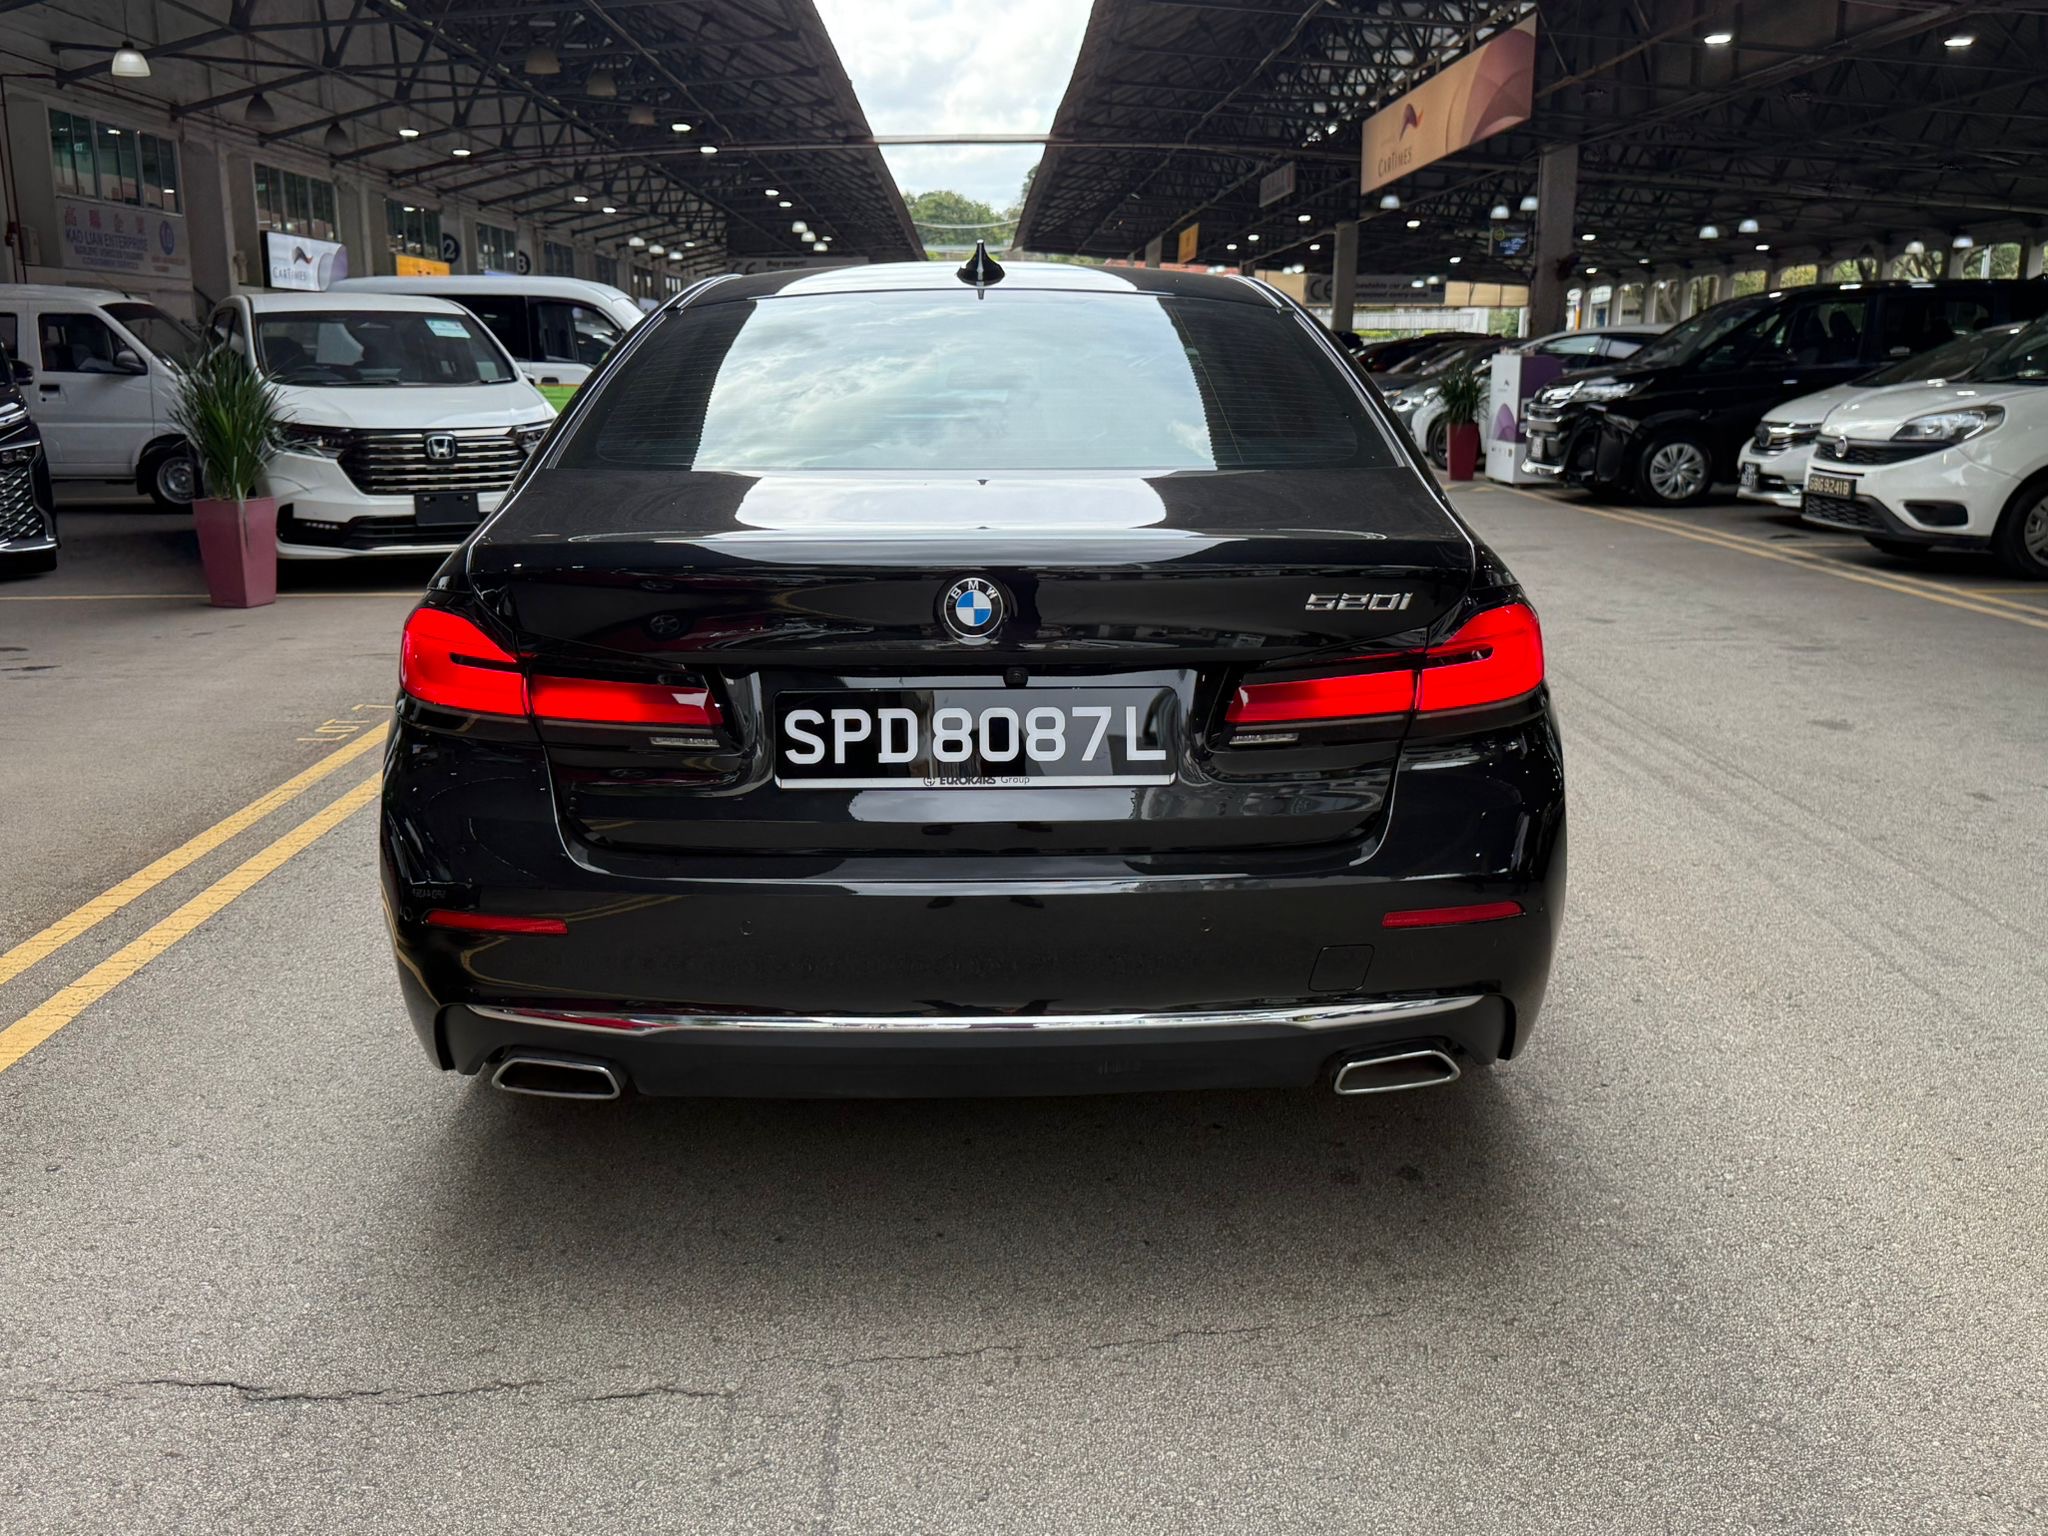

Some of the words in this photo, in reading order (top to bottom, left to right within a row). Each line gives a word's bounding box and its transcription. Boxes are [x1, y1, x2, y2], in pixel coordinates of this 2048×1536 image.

[1808, 477, 1849, 496] GBG9241B
[950, 580, 998, 600] BMW
[783, 705, 1168, 765] SPD8087L
[940, 776, 996, 785] EUROKARS
[1000, 776, 1031, 784] Group
